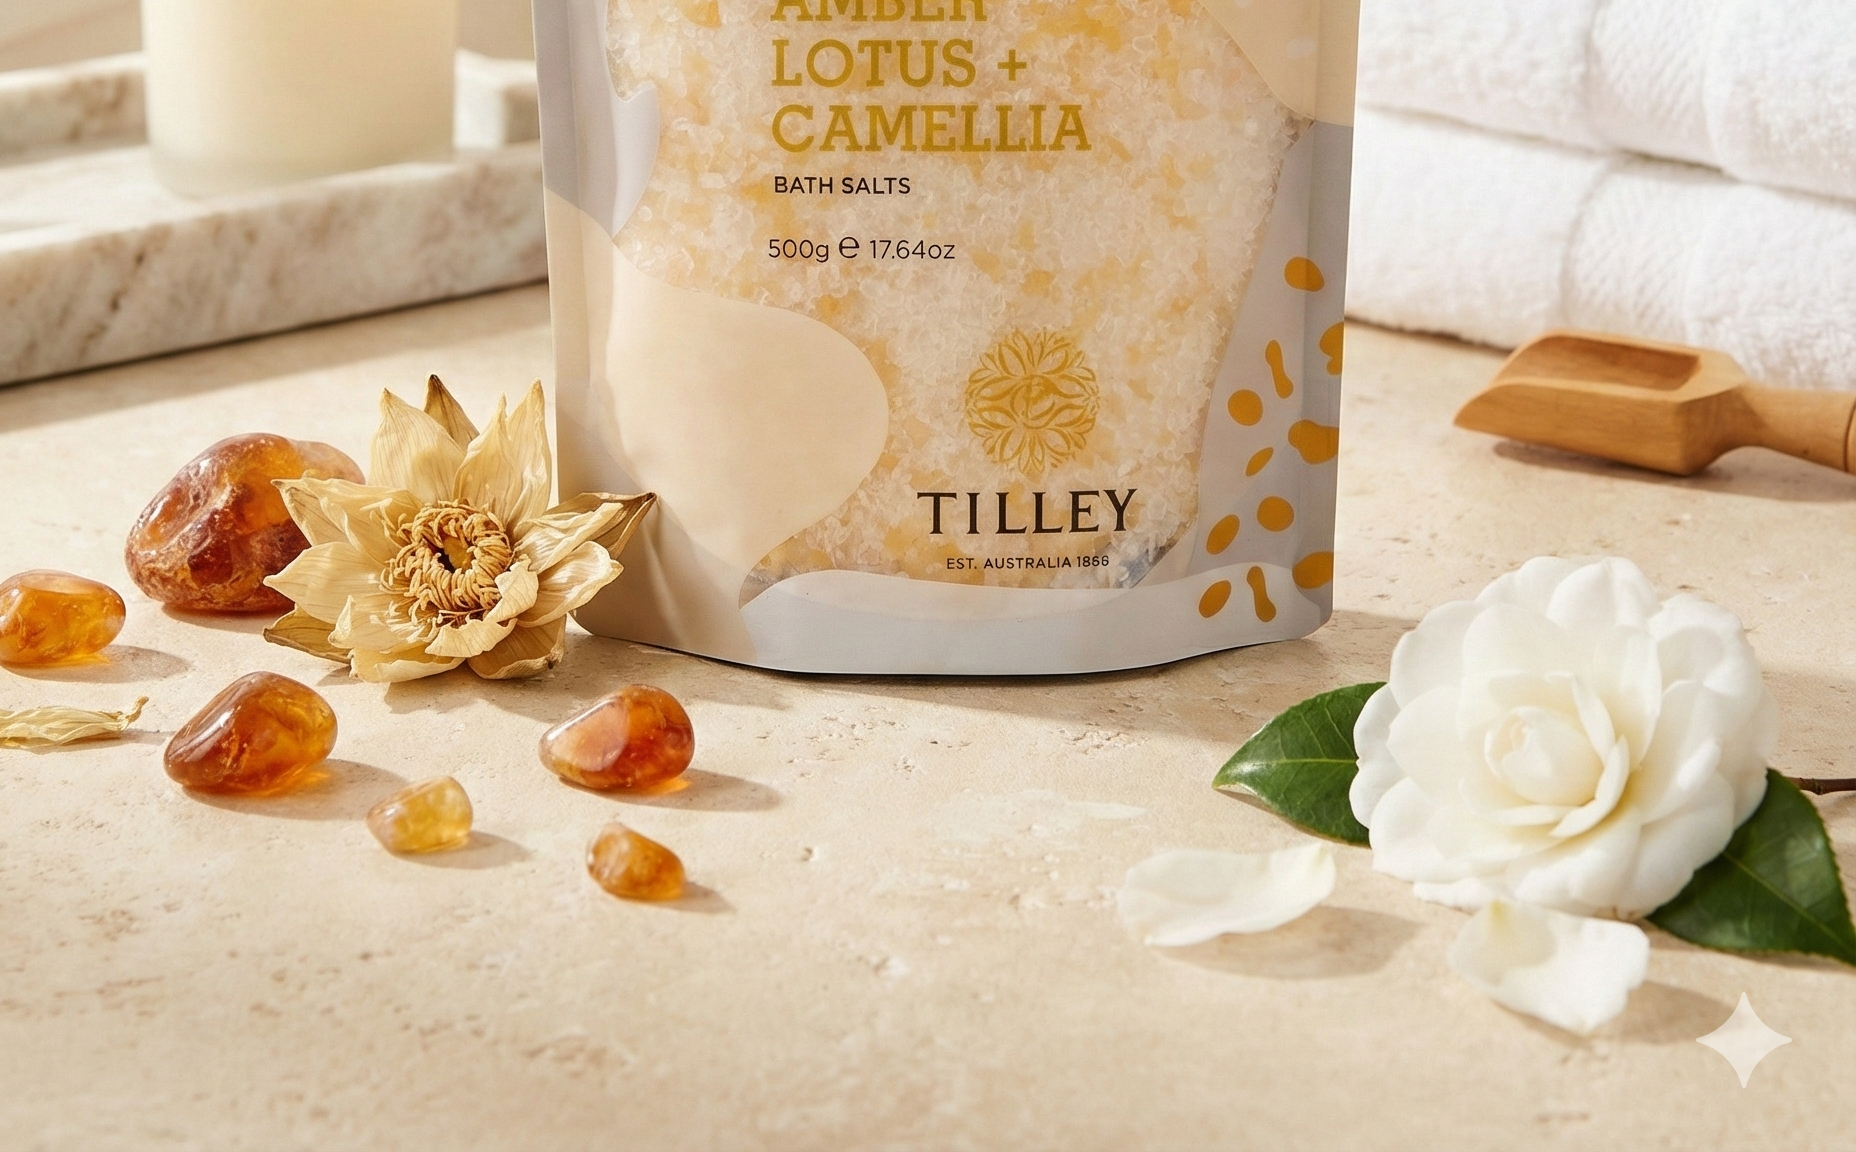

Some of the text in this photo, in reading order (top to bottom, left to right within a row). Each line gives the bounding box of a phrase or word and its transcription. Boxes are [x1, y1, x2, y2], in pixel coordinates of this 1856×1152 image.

[771, 38, 1027, 87] LOTUS +
[771, 104, 1092, 152] CAMELLIA
[774, 176, 911, 194] BATH SALTS
[768, 239, 829, 262] 500g
[869, 239, 955, 259] 17.64oz
[917, 488, 1137, 534] TILLEY
[946, 557, 977, 570] EST.
[983, 556, 1071, 569] AUSTRALIA
